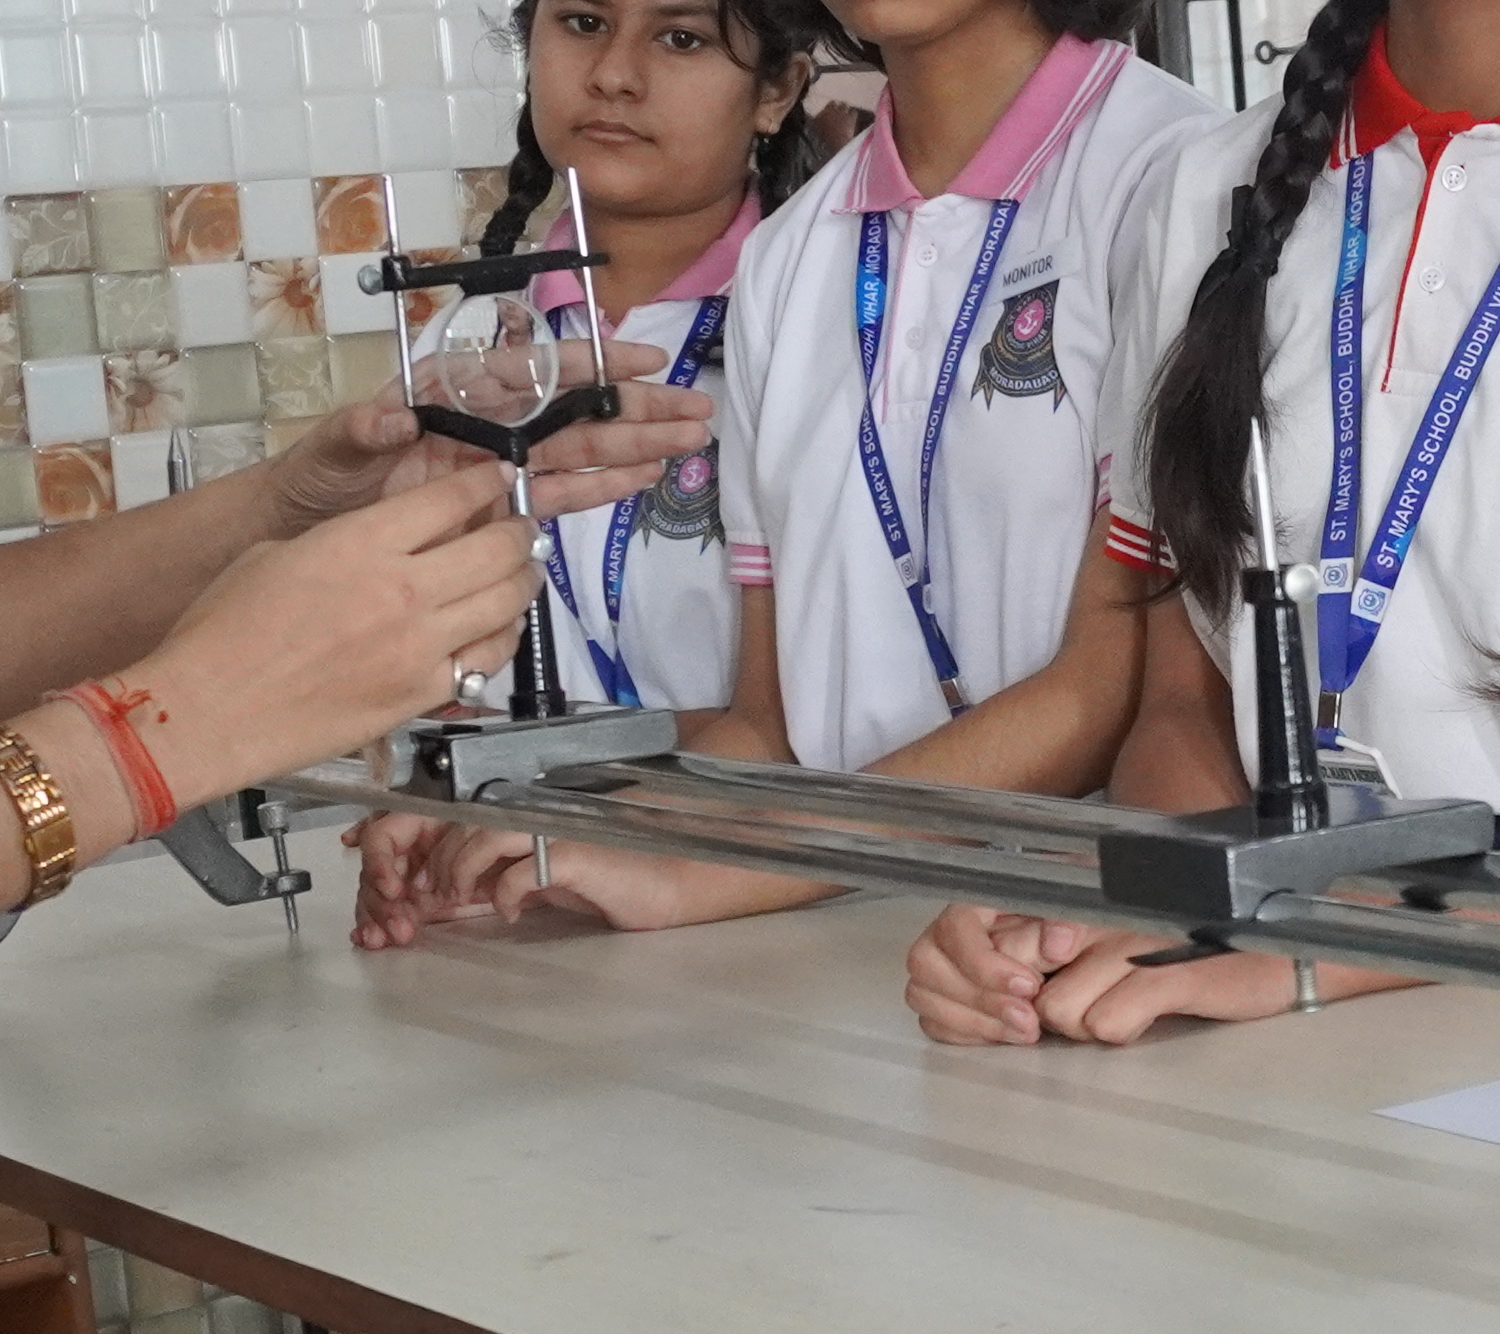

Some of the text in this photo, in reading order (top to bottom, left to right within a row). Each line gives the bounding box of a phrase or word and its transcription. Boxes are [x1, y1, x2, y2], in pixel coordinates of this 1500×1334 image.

[865, 211, 882, 274] MORADA
[1002, 254, 1053, 287] MONITOR
[863, 276, 881, 325] VIHAR,
[937, 334, 964, 396] BUDDHI
[957, 279, 985, 332] VIHAR,
[977, 200, 1012, 276] MORADA
[1329, 155, 1367, 542] ST. MARY'S SCHOOL, BUDDHI VIHAR, MORADA
[1453, 311, 1499, 381] BUDDHI
[989, 366, 1059, 391] MORADABAD
[1417, 385, 1468, 466] SCHOOL,
[868, 455, 894, 516] MARY'S
[1387, 467, 1428, 538] MARY'S
[608, 528, 626, 583] MARY'S
[617, 491, 638, 525] SCH
[886, 517, 902, 542] ST.
[1376, 541, 1401, 568] ST.
